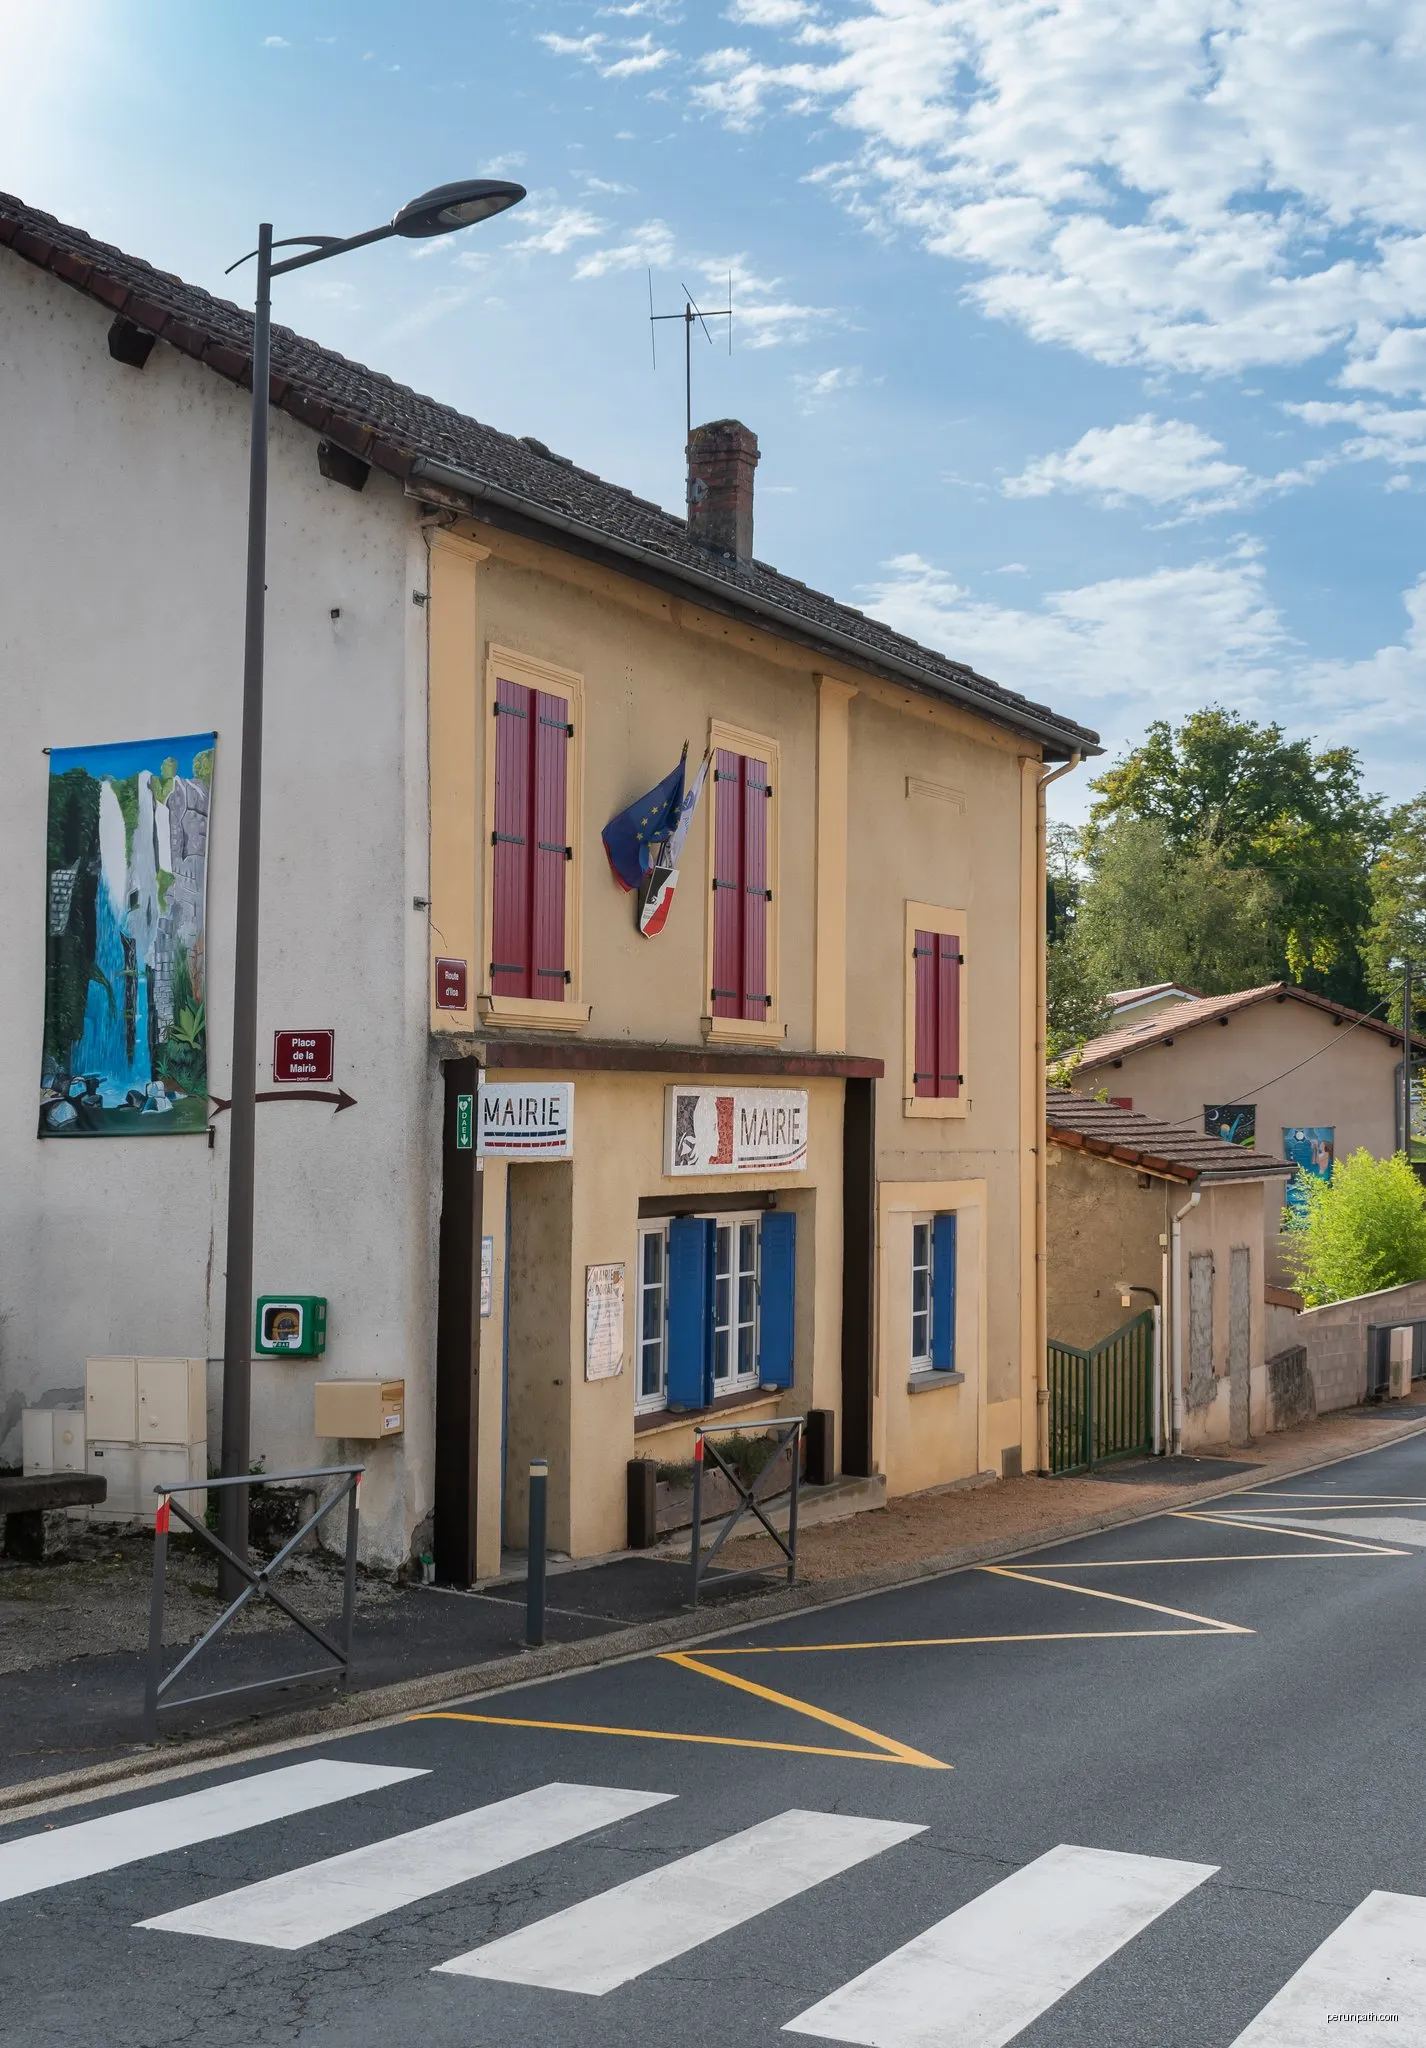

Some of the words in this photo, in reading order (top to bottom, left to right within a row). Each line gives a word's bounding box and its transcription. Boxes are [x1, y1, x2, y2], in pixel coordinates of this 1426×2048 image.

[444, 971, 459, 981] Route
[291, 1038, 316, 1047] Place
[292, 1051, 304, 1060] de
[306, 1051, 314, 1060] la
[289, 1064, 317, 1073] Mairie
[483, 1097, 561, 1126] MAIRIE
[740, 1107, 802, 1146] MAIRIE
[592, 1269, 614, 1283] MAIRIE
